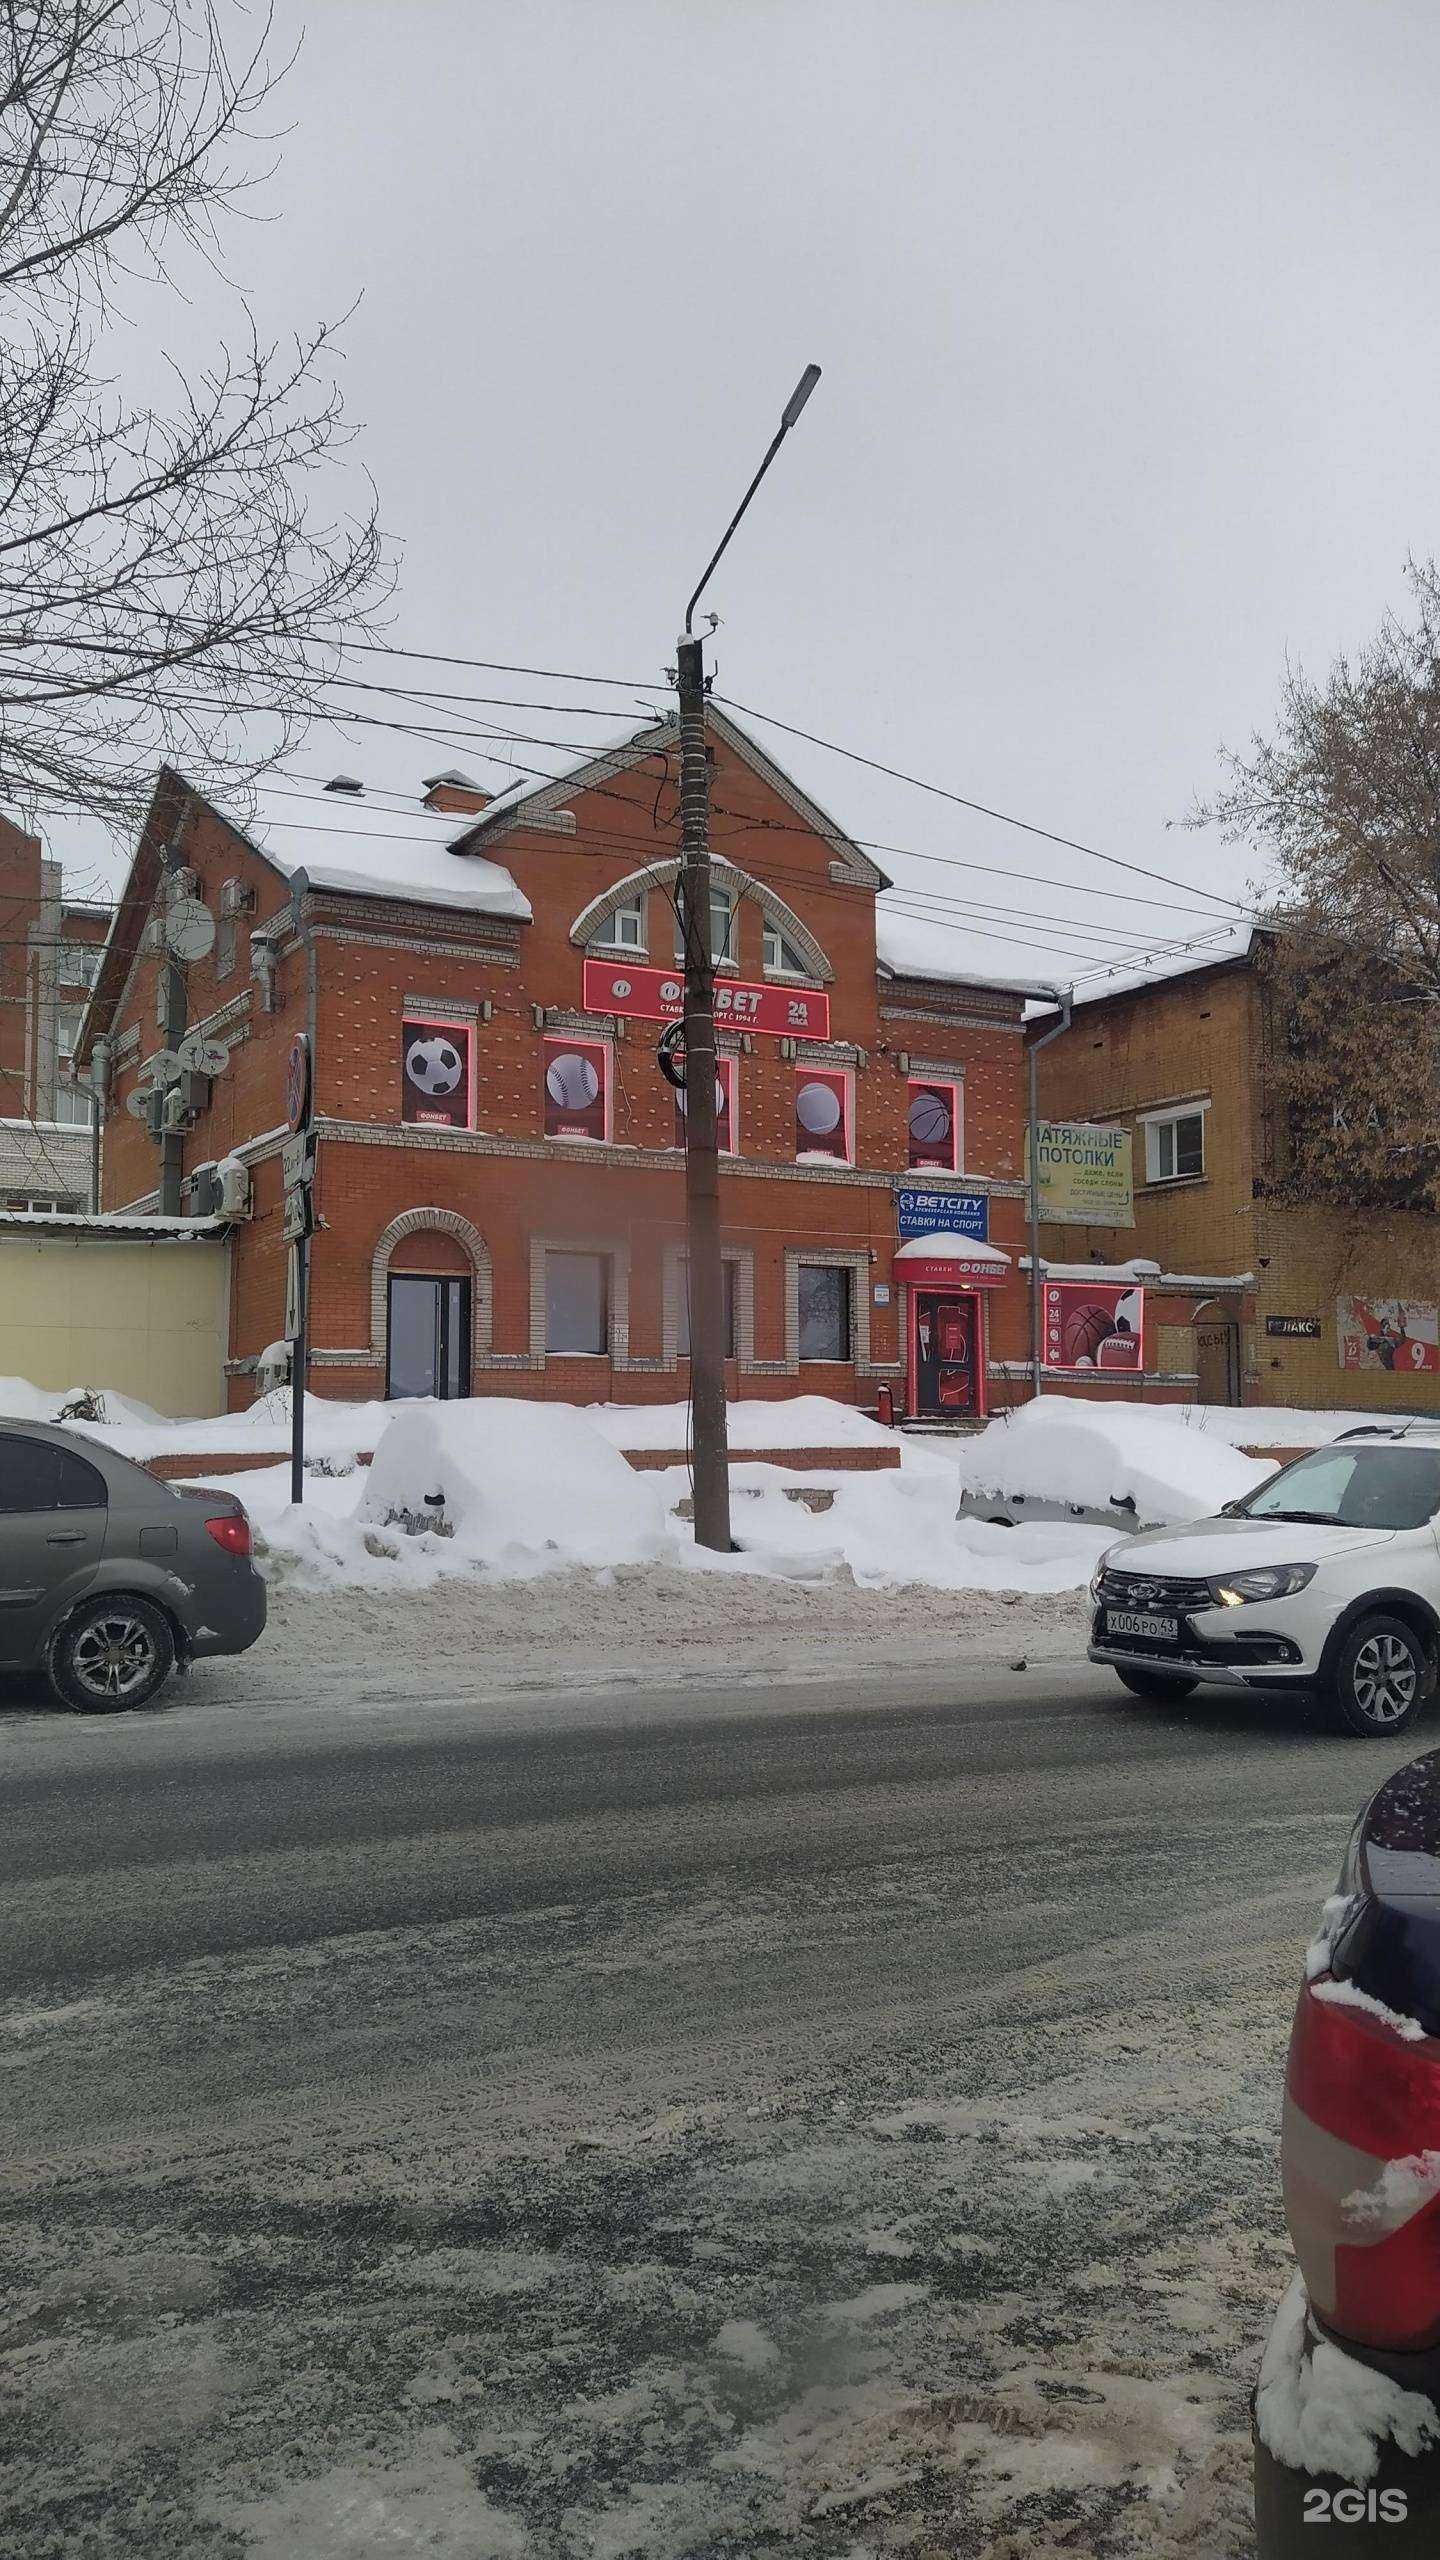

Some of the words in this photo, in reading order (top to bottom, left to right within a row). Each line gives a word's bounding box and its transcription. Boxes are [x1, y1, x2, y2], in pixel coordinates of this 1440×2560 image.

[660, 981, 763, 1013] ФБЕТ
[660, 1004, 684, 1014] СТАВК
[788, 1000, 808, 1017] 24
[1036, 1127, 1123, 1149] АТЯЖНЫЕ
[1040, 1146, 1114, 1167] ПОТОЛКИ
[916, 1195, 983, 1211] BETCITY
[900, 1215, 936, 1227] СТАВКИ
[938, 1218, 951, 1228] НА
[952, 1219, 984, 1231] СПОРТ
[925, 1265, 953, 1273] СТАВКИ
[960, 1262, 1008, 1275] ФОНБЕТ
[1049, 1309, 1060, 1318] 24
[1411, 1342, 1425, 1370] 9
